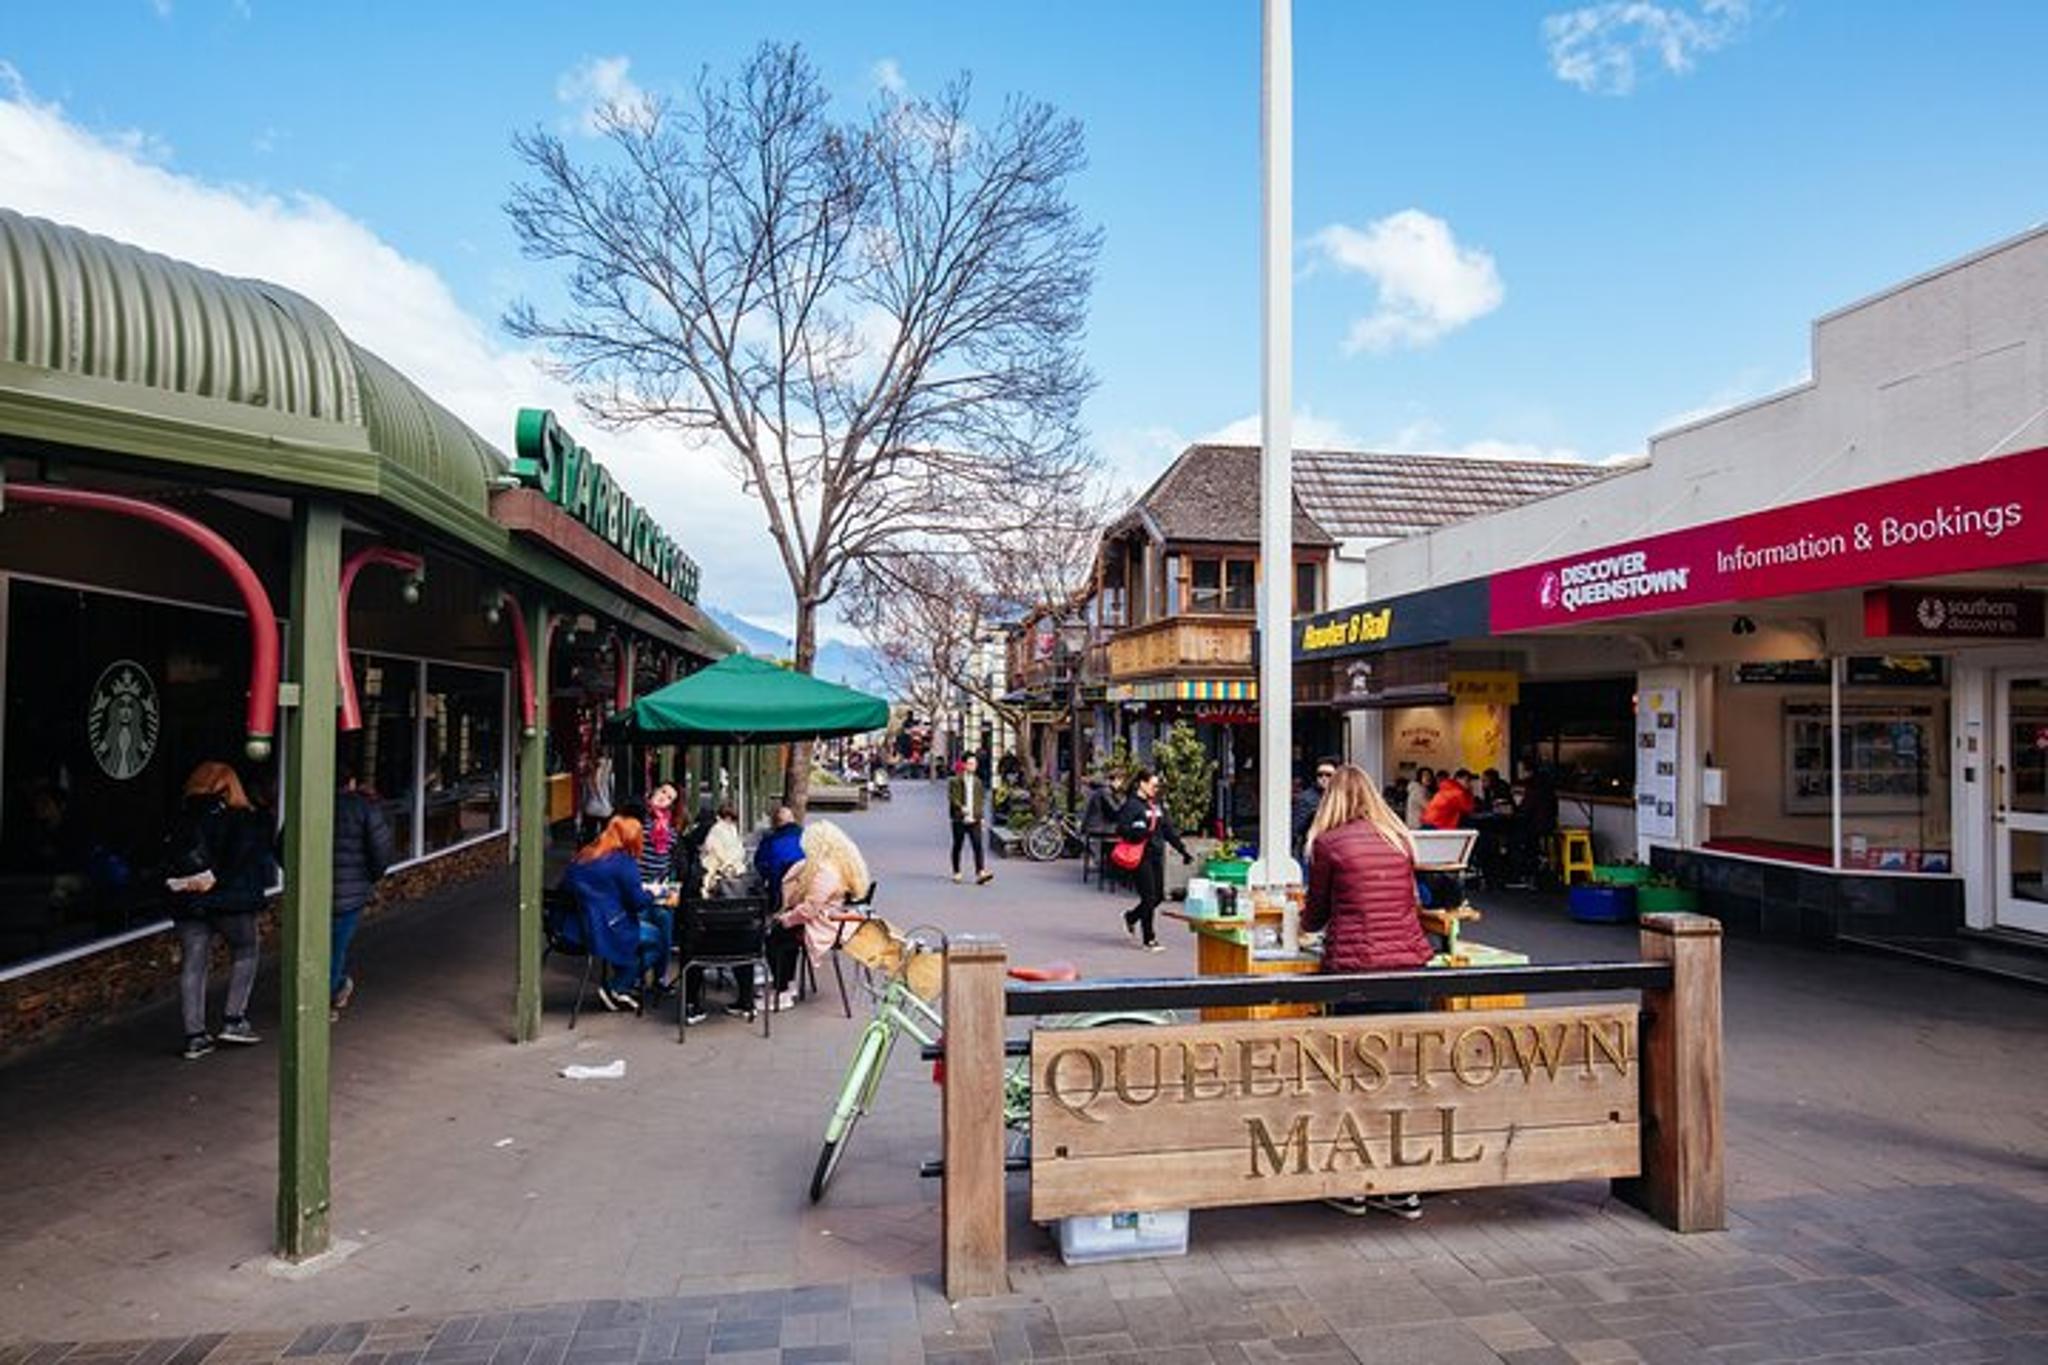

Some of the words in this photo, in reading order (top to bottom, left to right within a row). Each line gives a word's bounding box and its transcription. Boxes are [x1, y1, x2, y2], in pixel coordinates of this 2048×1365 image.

[512, 407, 664, 584] STARBUCKS
[1717, 533, 1846, 573] Information
[1854, 522, 1873, 551] &
[1881, 501, 2023, 547] Bookings
[1560, 551, 1647, 587] DISCOVER
[1561, 568, 1688, 612] QUEENSTOWN
[1946, 616, 2018, 633] discoveries
[1947, 598, 2018, 617] southern
[1044, 1014, 1633, 1125] QUEENSTOWN
[1242, 1105, 1486, 1180] MALL
